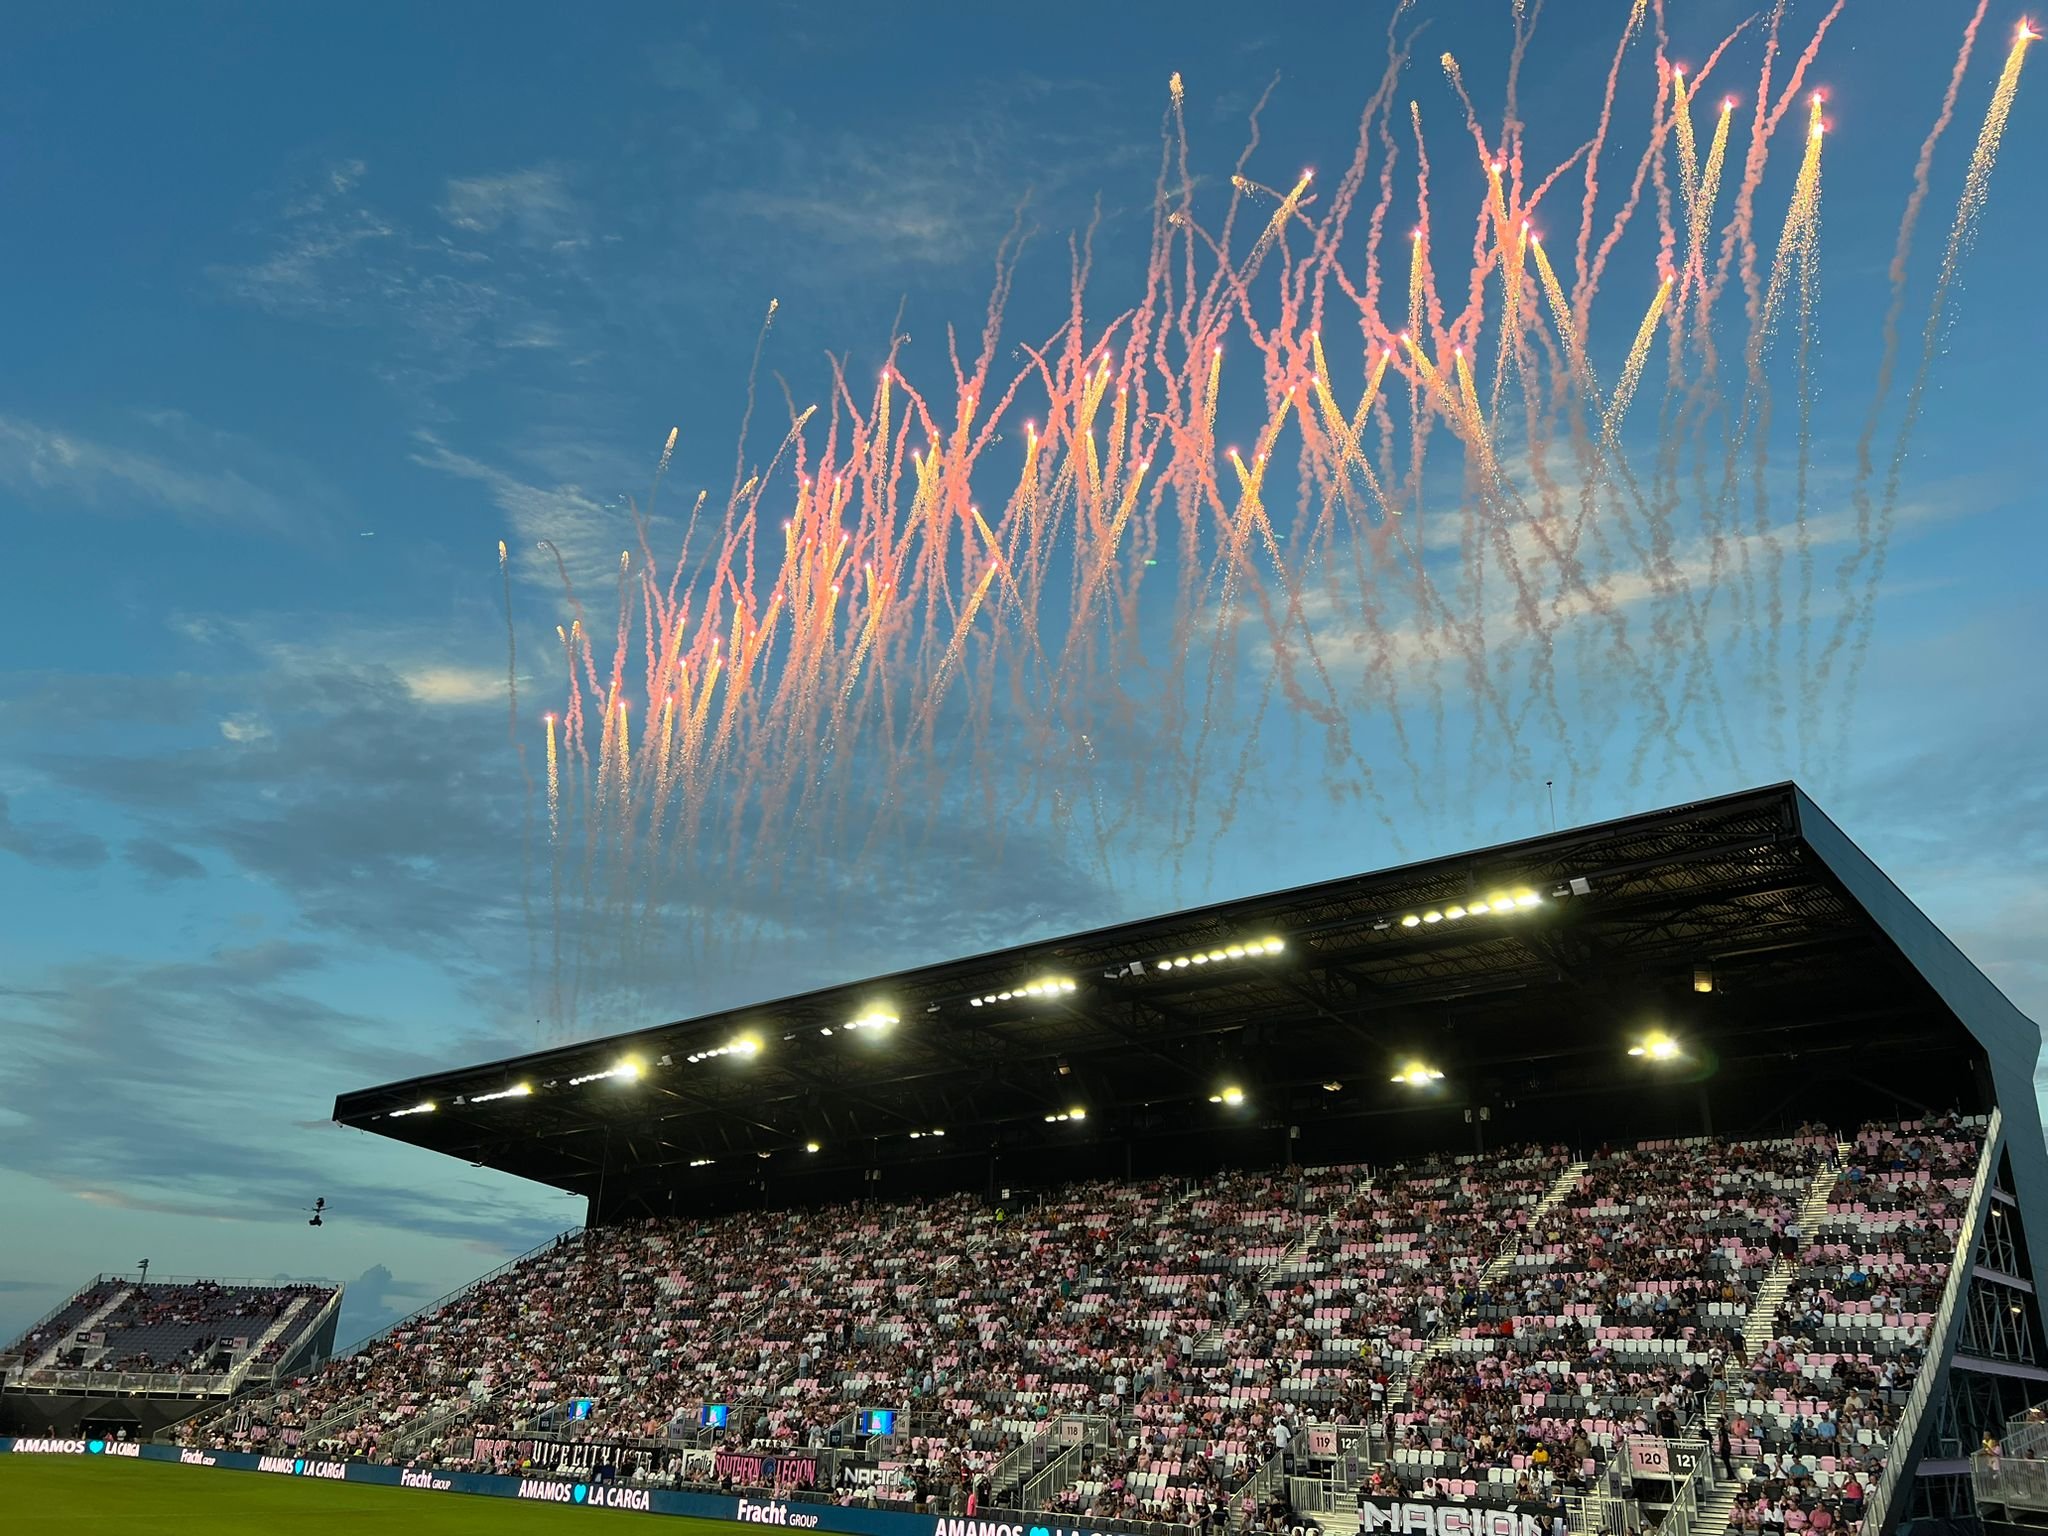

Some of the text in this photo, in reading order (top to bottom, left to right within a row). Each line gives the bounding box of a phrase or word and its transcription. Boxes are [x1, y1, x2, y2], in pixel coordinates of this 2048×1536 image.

[1067, 1426, 1079, 1436] 118
[12, 1439, 86, 1453] AMAMOS
[104, 1441, 117, 1455] LA
[1316, 1436, 1331, 1448] 119
[1341, 1437, 1359, 1450] 120
[180, 1448, 204, 1464] Fracht
[532, 1440, 570, 1466] VICE
[571, 1444, 611, 1467] CITY
[1639, 1452, 1662, 1465] 120
[1676, 1454, 1697, 1468] 121
[257, 1456, 346, 1480] AMAMOS LA CARGA
[776, 1459, 817, 1487] LEGION
[400, 1468, 432, 1489] Fracht
[518, 1479, 651, 1511] AMAMOS LA CARGA
[737, 1499, 818, 1528] Fracht GROUP
